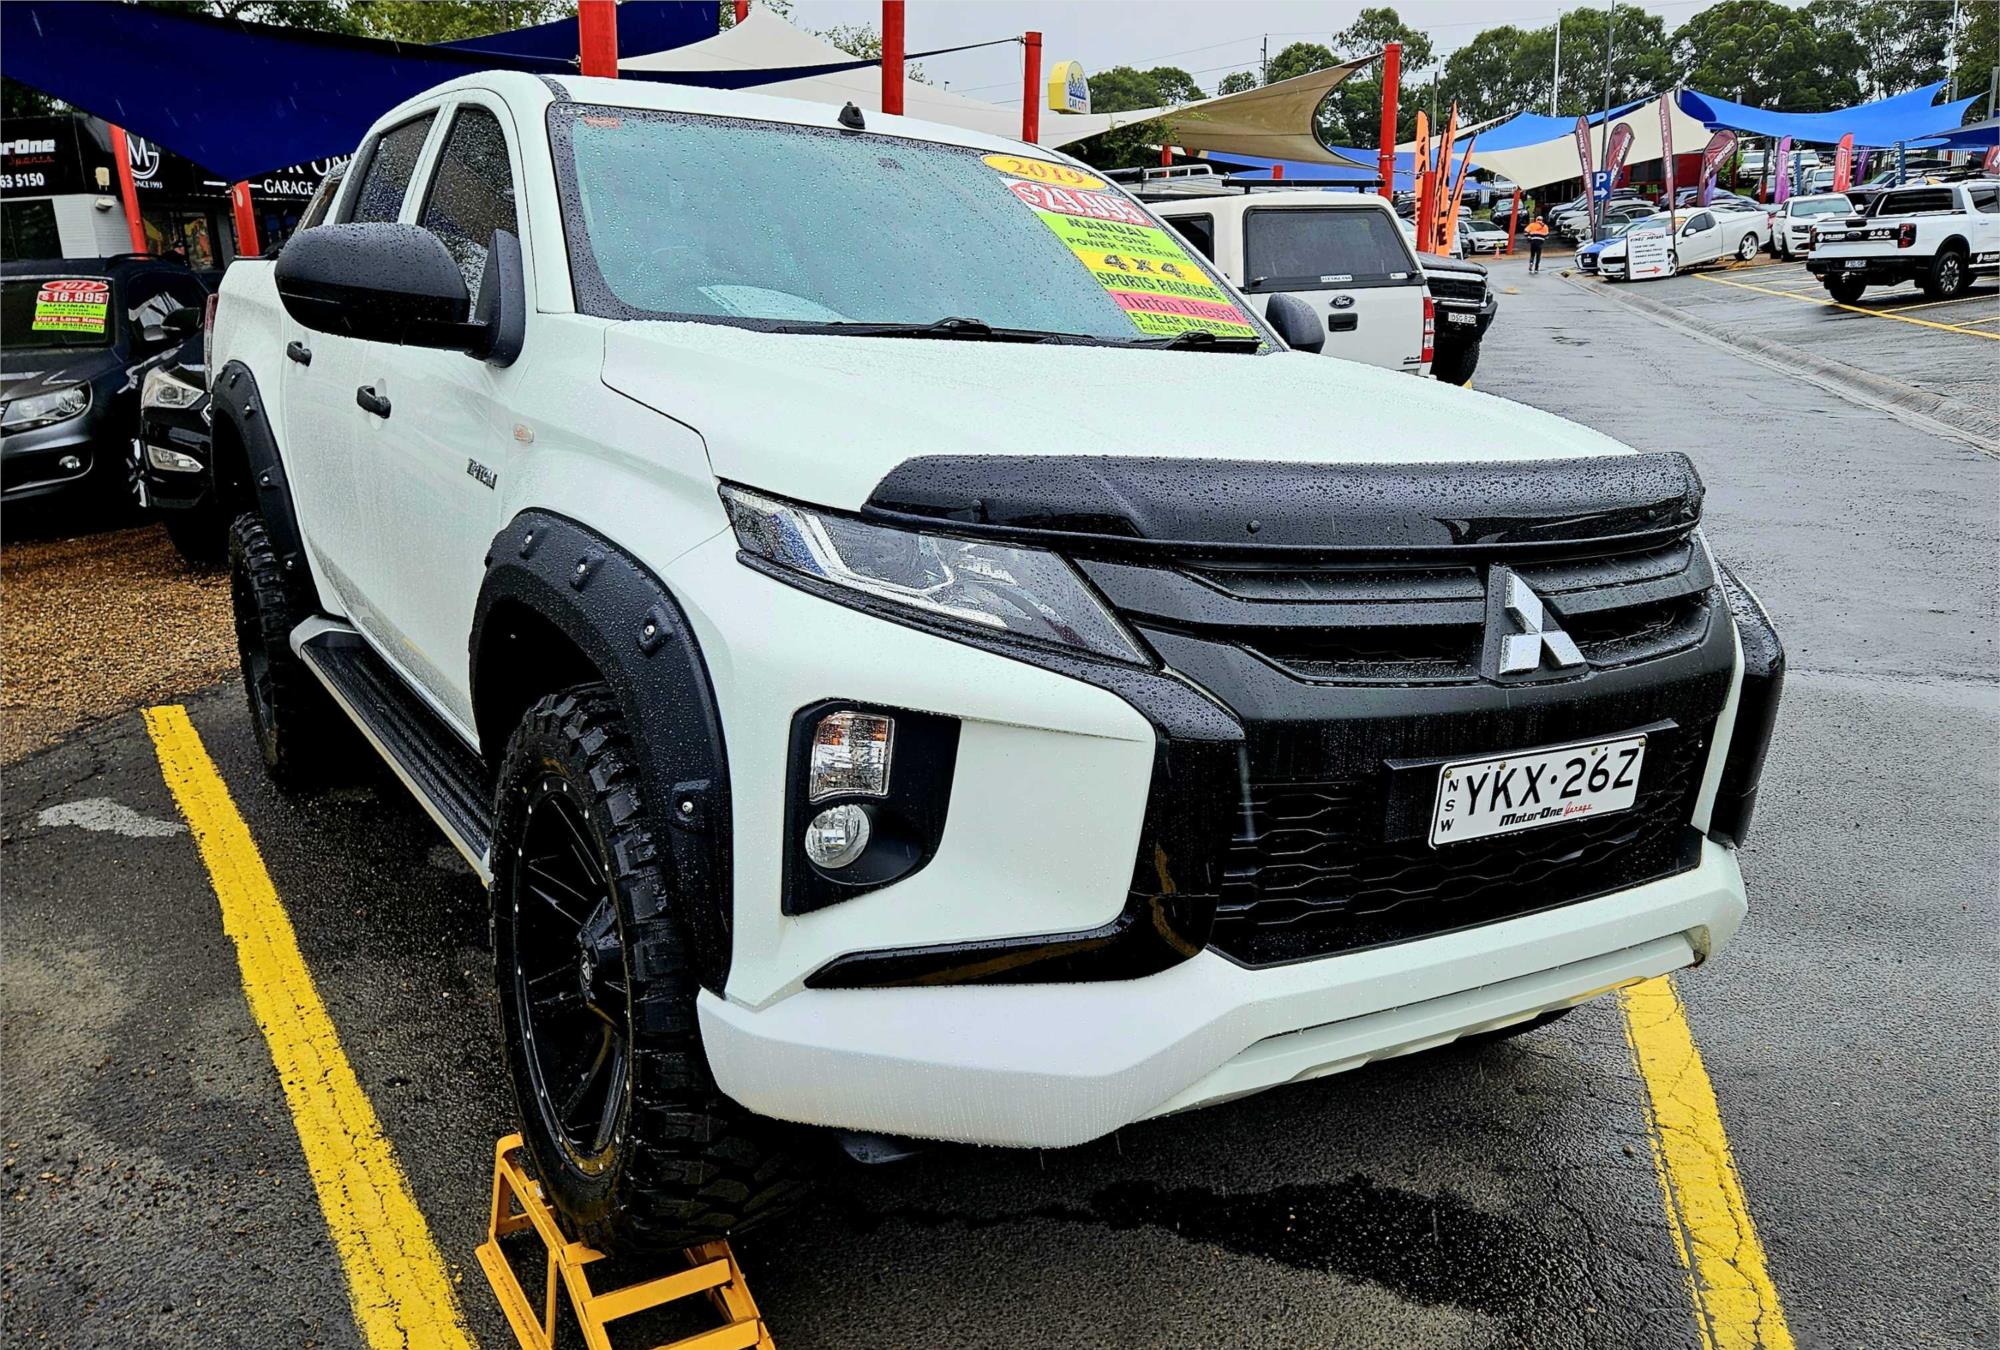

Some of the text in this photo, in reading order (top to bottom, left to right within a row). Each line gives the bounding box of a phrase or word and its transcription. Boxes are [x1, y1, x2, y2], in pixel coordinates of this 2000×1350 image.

[15, 172, 45, 187] 5150
[1008, 160, 1084, 183] 2019
[1596, 172, 1607, 187] P
[264, 179, 314, 195] GARAGE
[1066, 217, 1150, 239] MANUAL
[1087, 231, 1108, 239] AIR
[1066, 237, 1188, 261] POWER STEERING
[1096, 272, 1222, 300] SPORTS PACKAGE
[40, 292, 104, 304] $16,995
[1118, 293, 1242, 321] Turbo Diesel
[1132, 312, 1255, 336] 5 YEAR WARRANTY
[1499, 801, 1593, 827] MotorOne Garage
